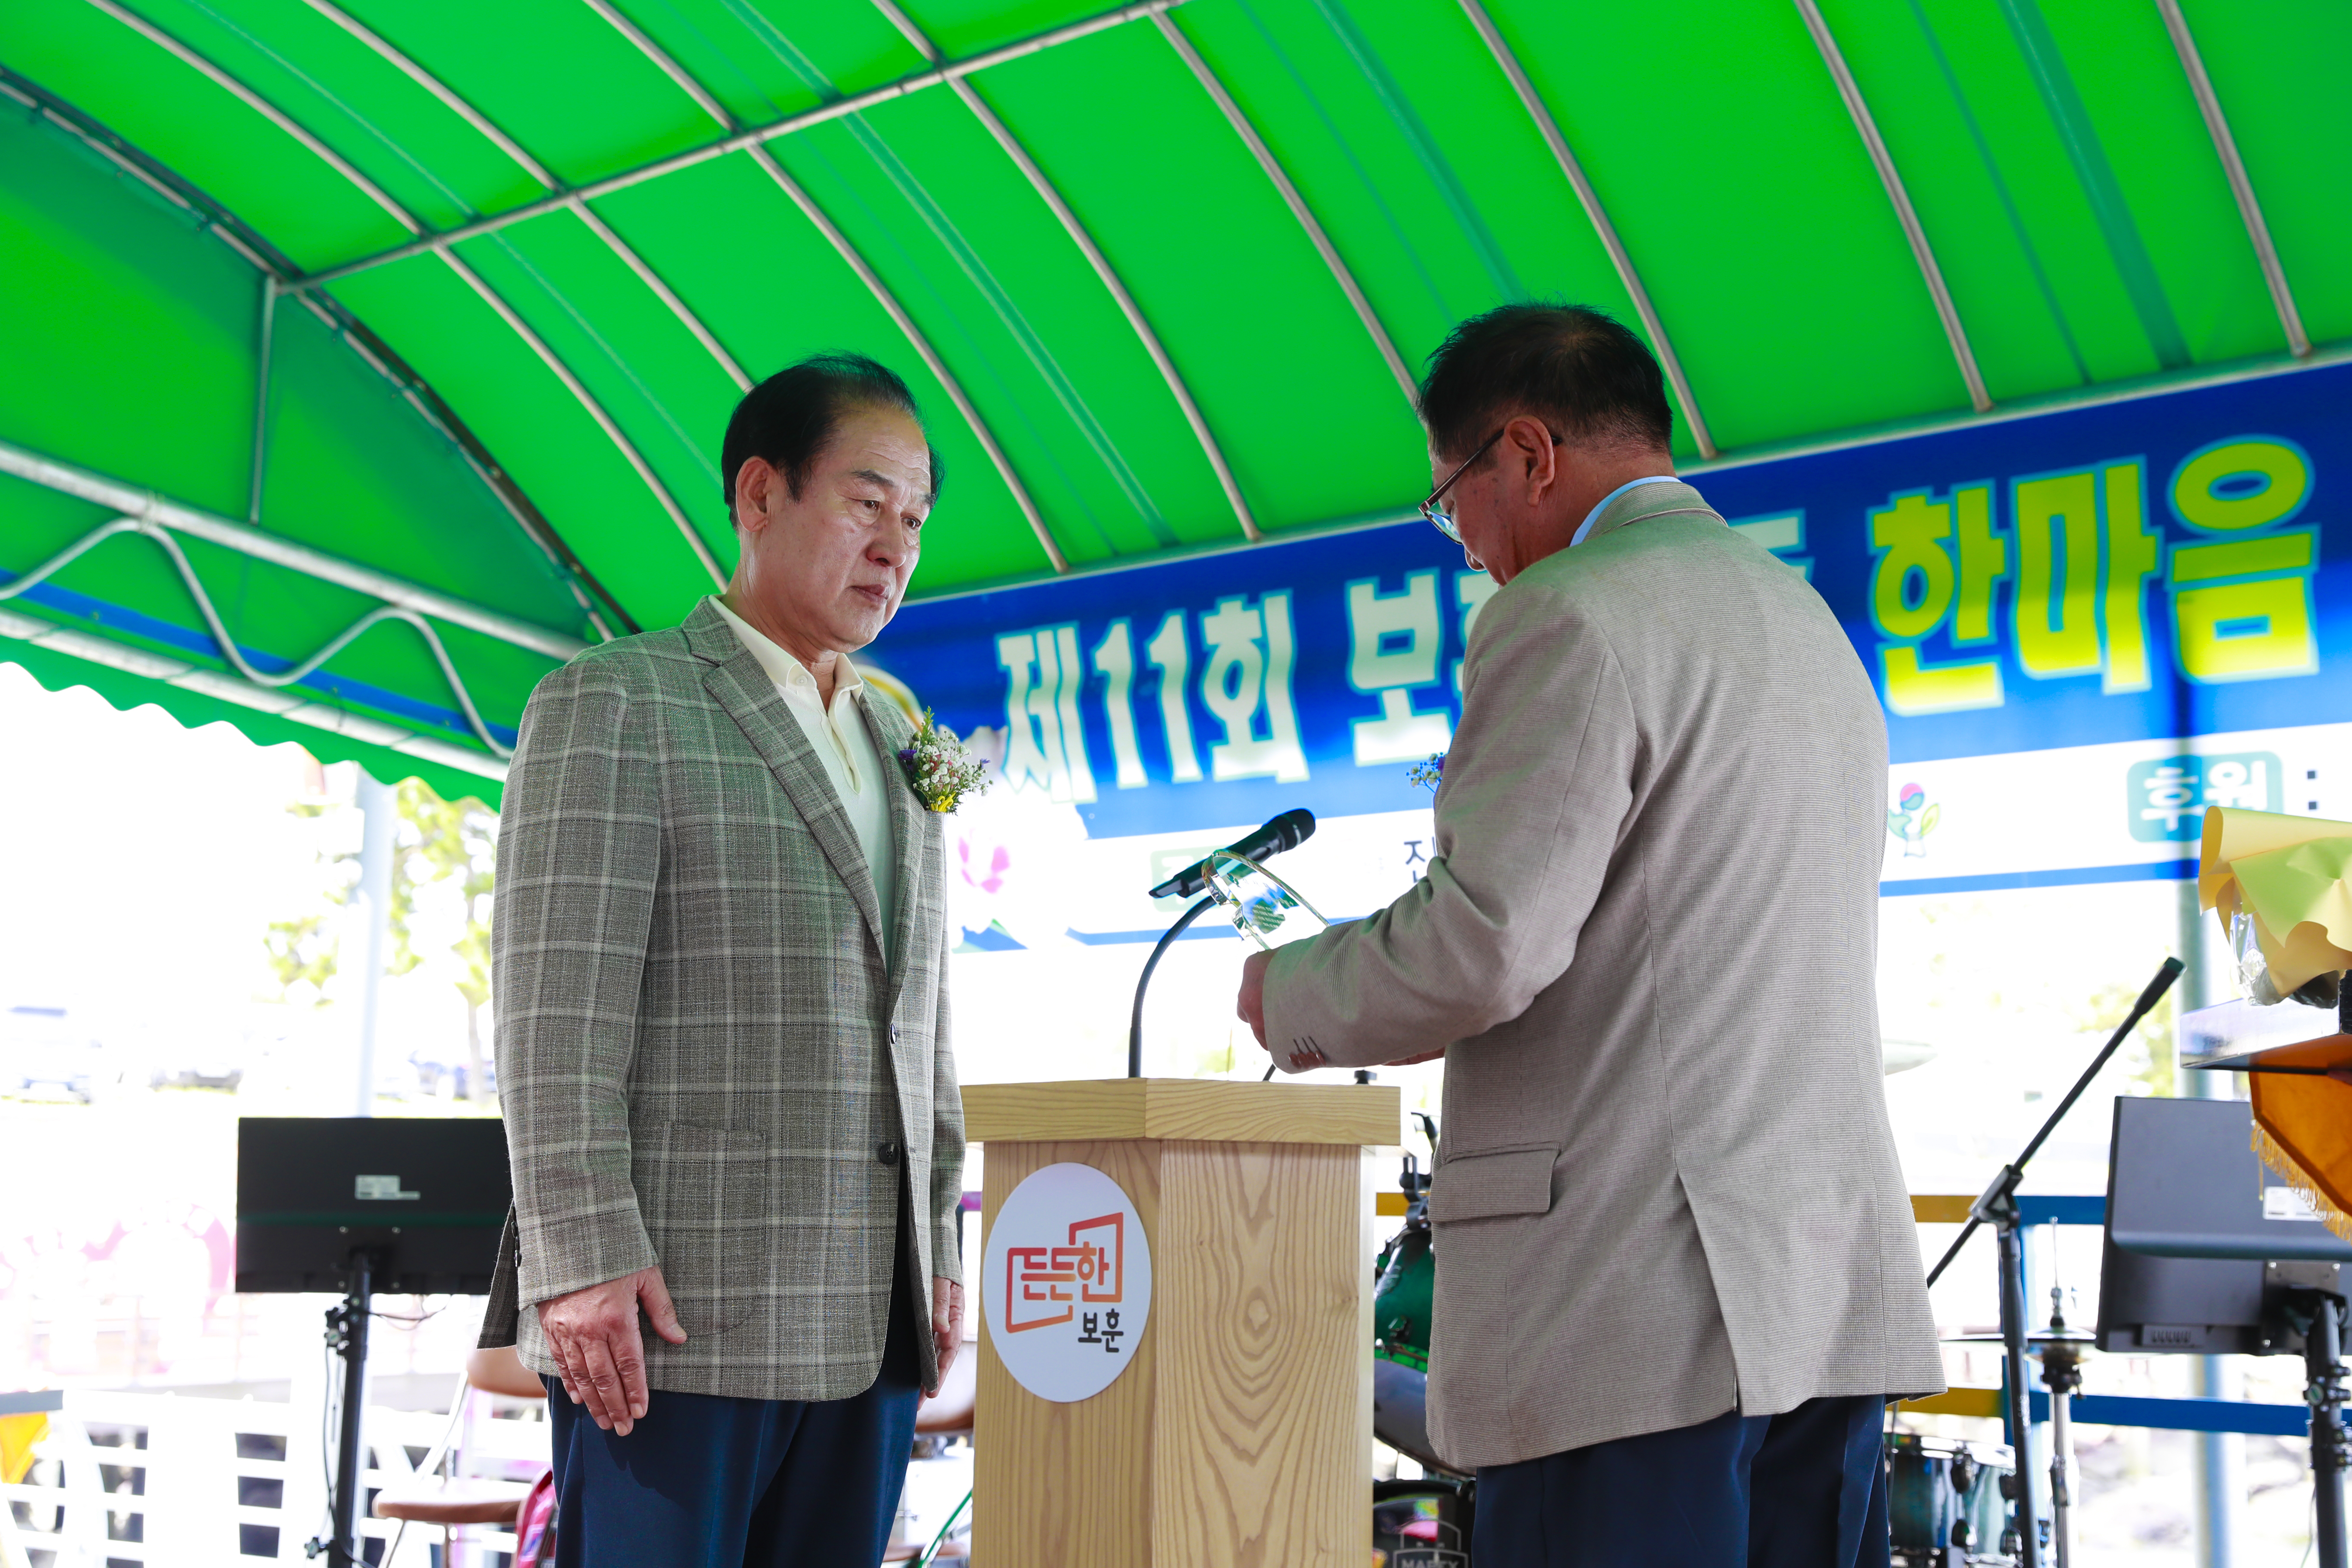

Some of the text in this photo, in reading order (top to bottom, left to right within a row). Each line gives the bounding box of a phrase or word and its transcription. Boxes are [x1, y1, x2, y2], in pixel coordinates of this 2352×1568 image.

[994, 588, 1310, 804] 제11회
[1867, 434, 2321, 717] 한마음
[1007, 1238, 1123, 1303] 든든한
[1078, 1308, 1124, 1353] 보훈
